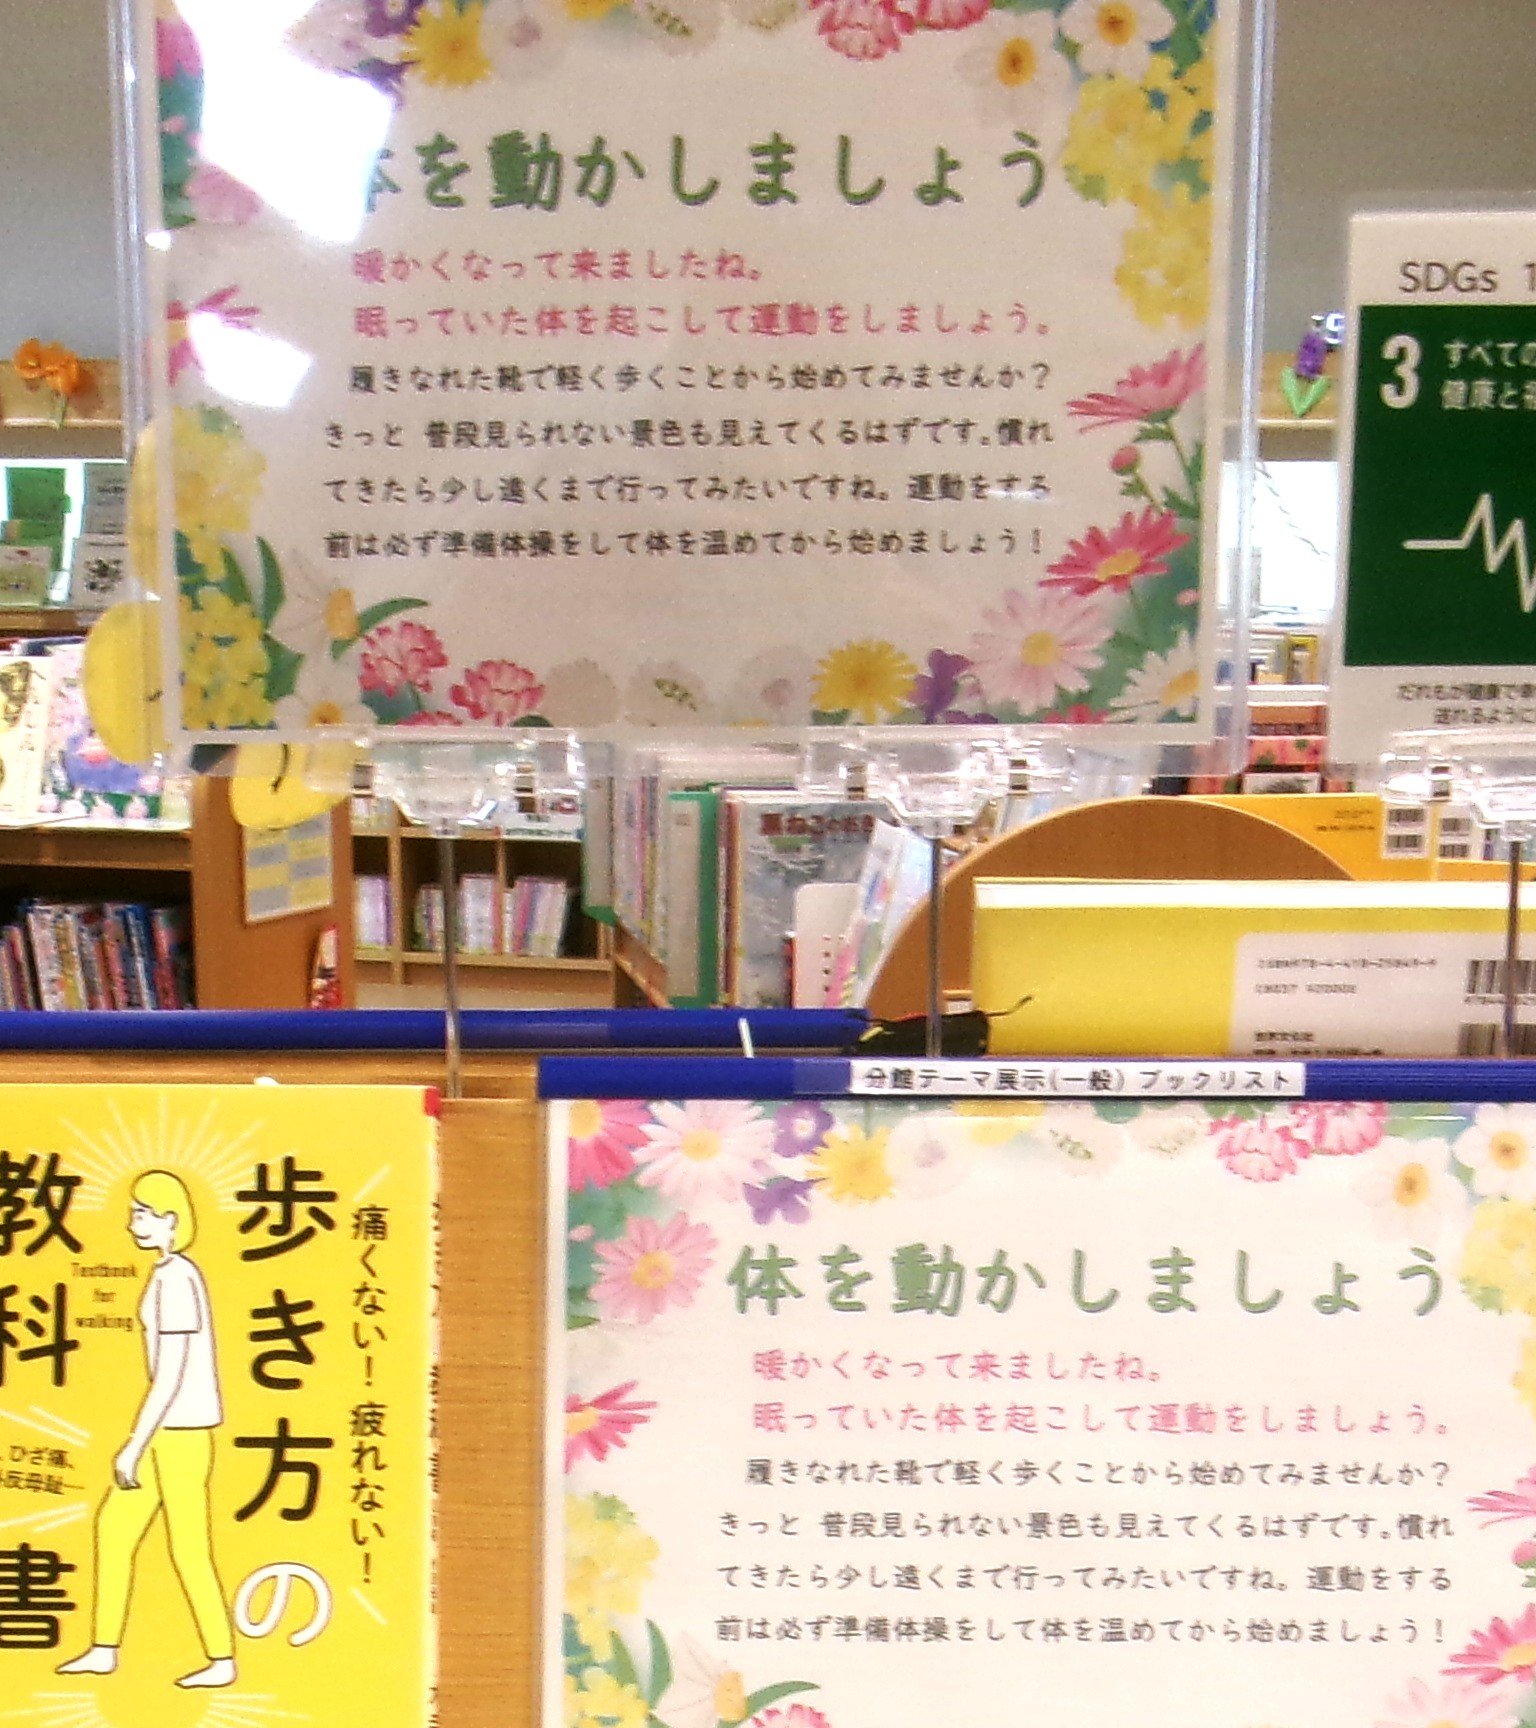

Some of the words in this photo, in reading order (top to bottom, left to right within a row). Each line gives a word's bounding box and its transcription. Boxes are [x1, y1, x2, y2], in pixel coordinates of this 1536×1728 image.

[353, 247, 765, 284] 暖かくなって来ましたね。
[1399, 261, 1498, 295] SDGs
[355, 303, 1052, 339] 眠っていた体を起こして運動をしましょう。
[350, 361, 1052, 397] 履きなれた靴で軽く歩くことから始めてみませんか？
[1380, 334, 1422, 409] 3
[325, 418, 404, 449] きっと
[325, 526, 1044, 560] 前は必ず準備体操をして体を温めてから始めましょう！
[865, 1067, 1126, 1098] 分館テーマ展示(一般)
[1141, 1067, 1294, 1094] ブックリスト
[726, 1244, 1445, 1318] 体を動かしましょう
[754, 1349, 1168, 1384] 暖かくなって来ましたね。
[234, 1155, 339, 1648] 歩き方の
[349, 1203, 390, 1588] 痛くない！疲れない！
[753, 1402, 1450, 1436] 眠っていた体を起こして運動をしましょう。
[746, 1456, 1450, 1491] 履きなれた靴で軽く歩くことから始めてみませんか？
[718, 1511, 802, 1538] きっと
[819, 1508, 1456, 1541] 普段見られない景色も見えてくるはずです。慣れ
[717, 1561, 1454, 1594] てきたら少し遠くまで行ってみたいですね。運動をする
[715, 1613, 1446, 1647] 前は必ず準備体操をして体を温めてから始めましょう！
